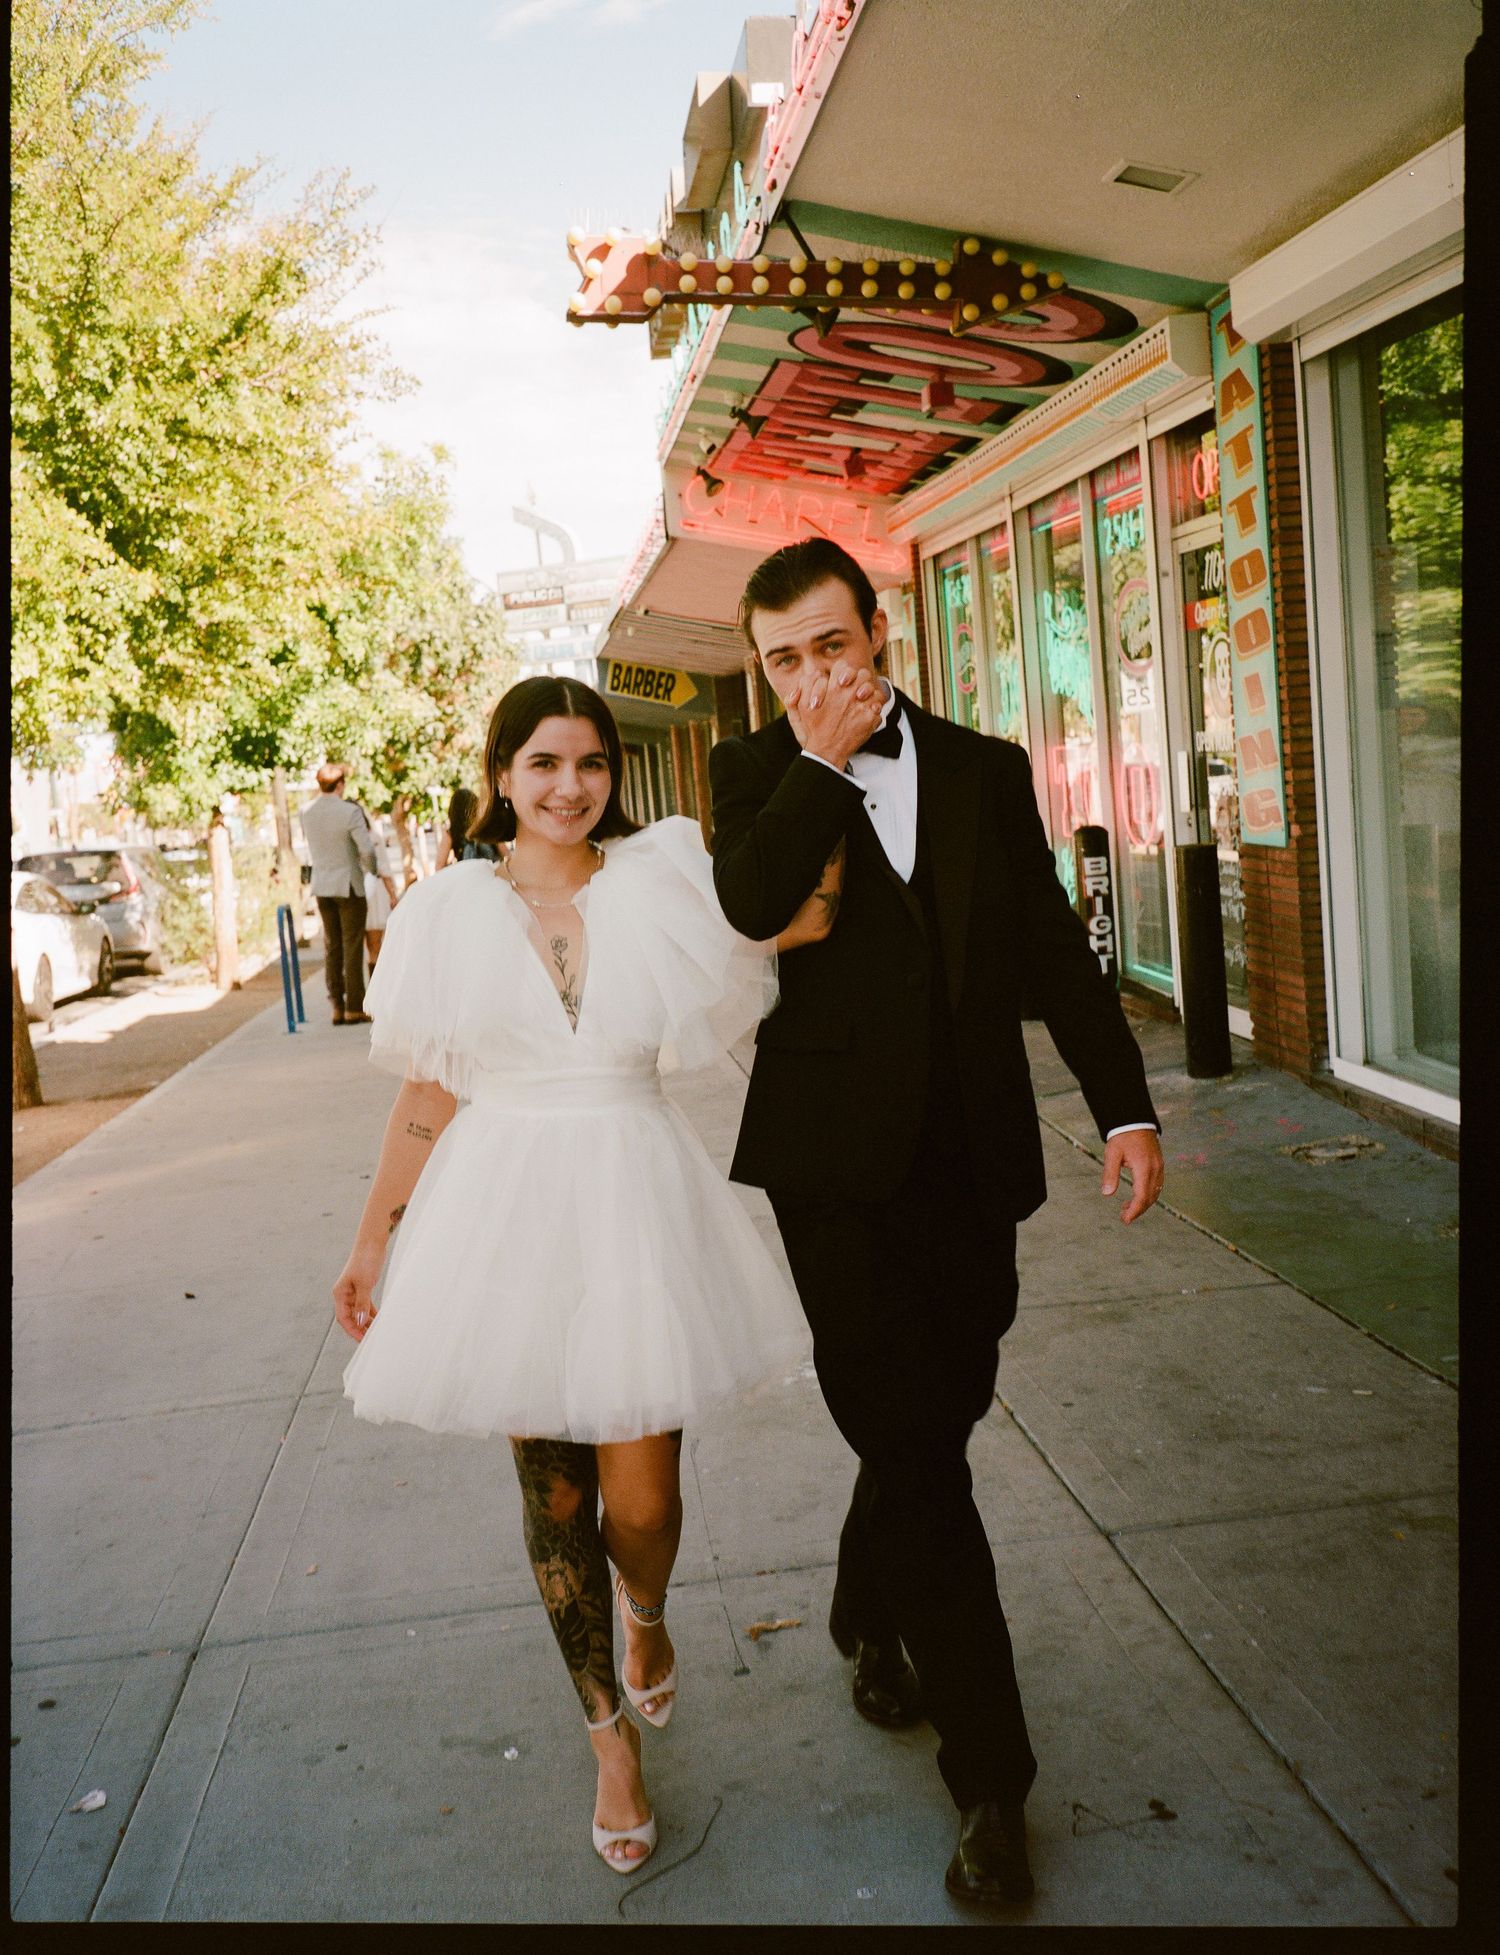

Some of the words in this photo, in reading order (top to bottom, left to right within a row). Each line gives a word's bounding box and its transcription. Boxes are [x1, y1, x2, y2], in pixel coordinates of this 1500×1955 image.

[685, 475, 881, 547] CHAPEL
[609, 661, 676, 702] BARBER
[1083, 856, 1114, 976] BRIGHT
